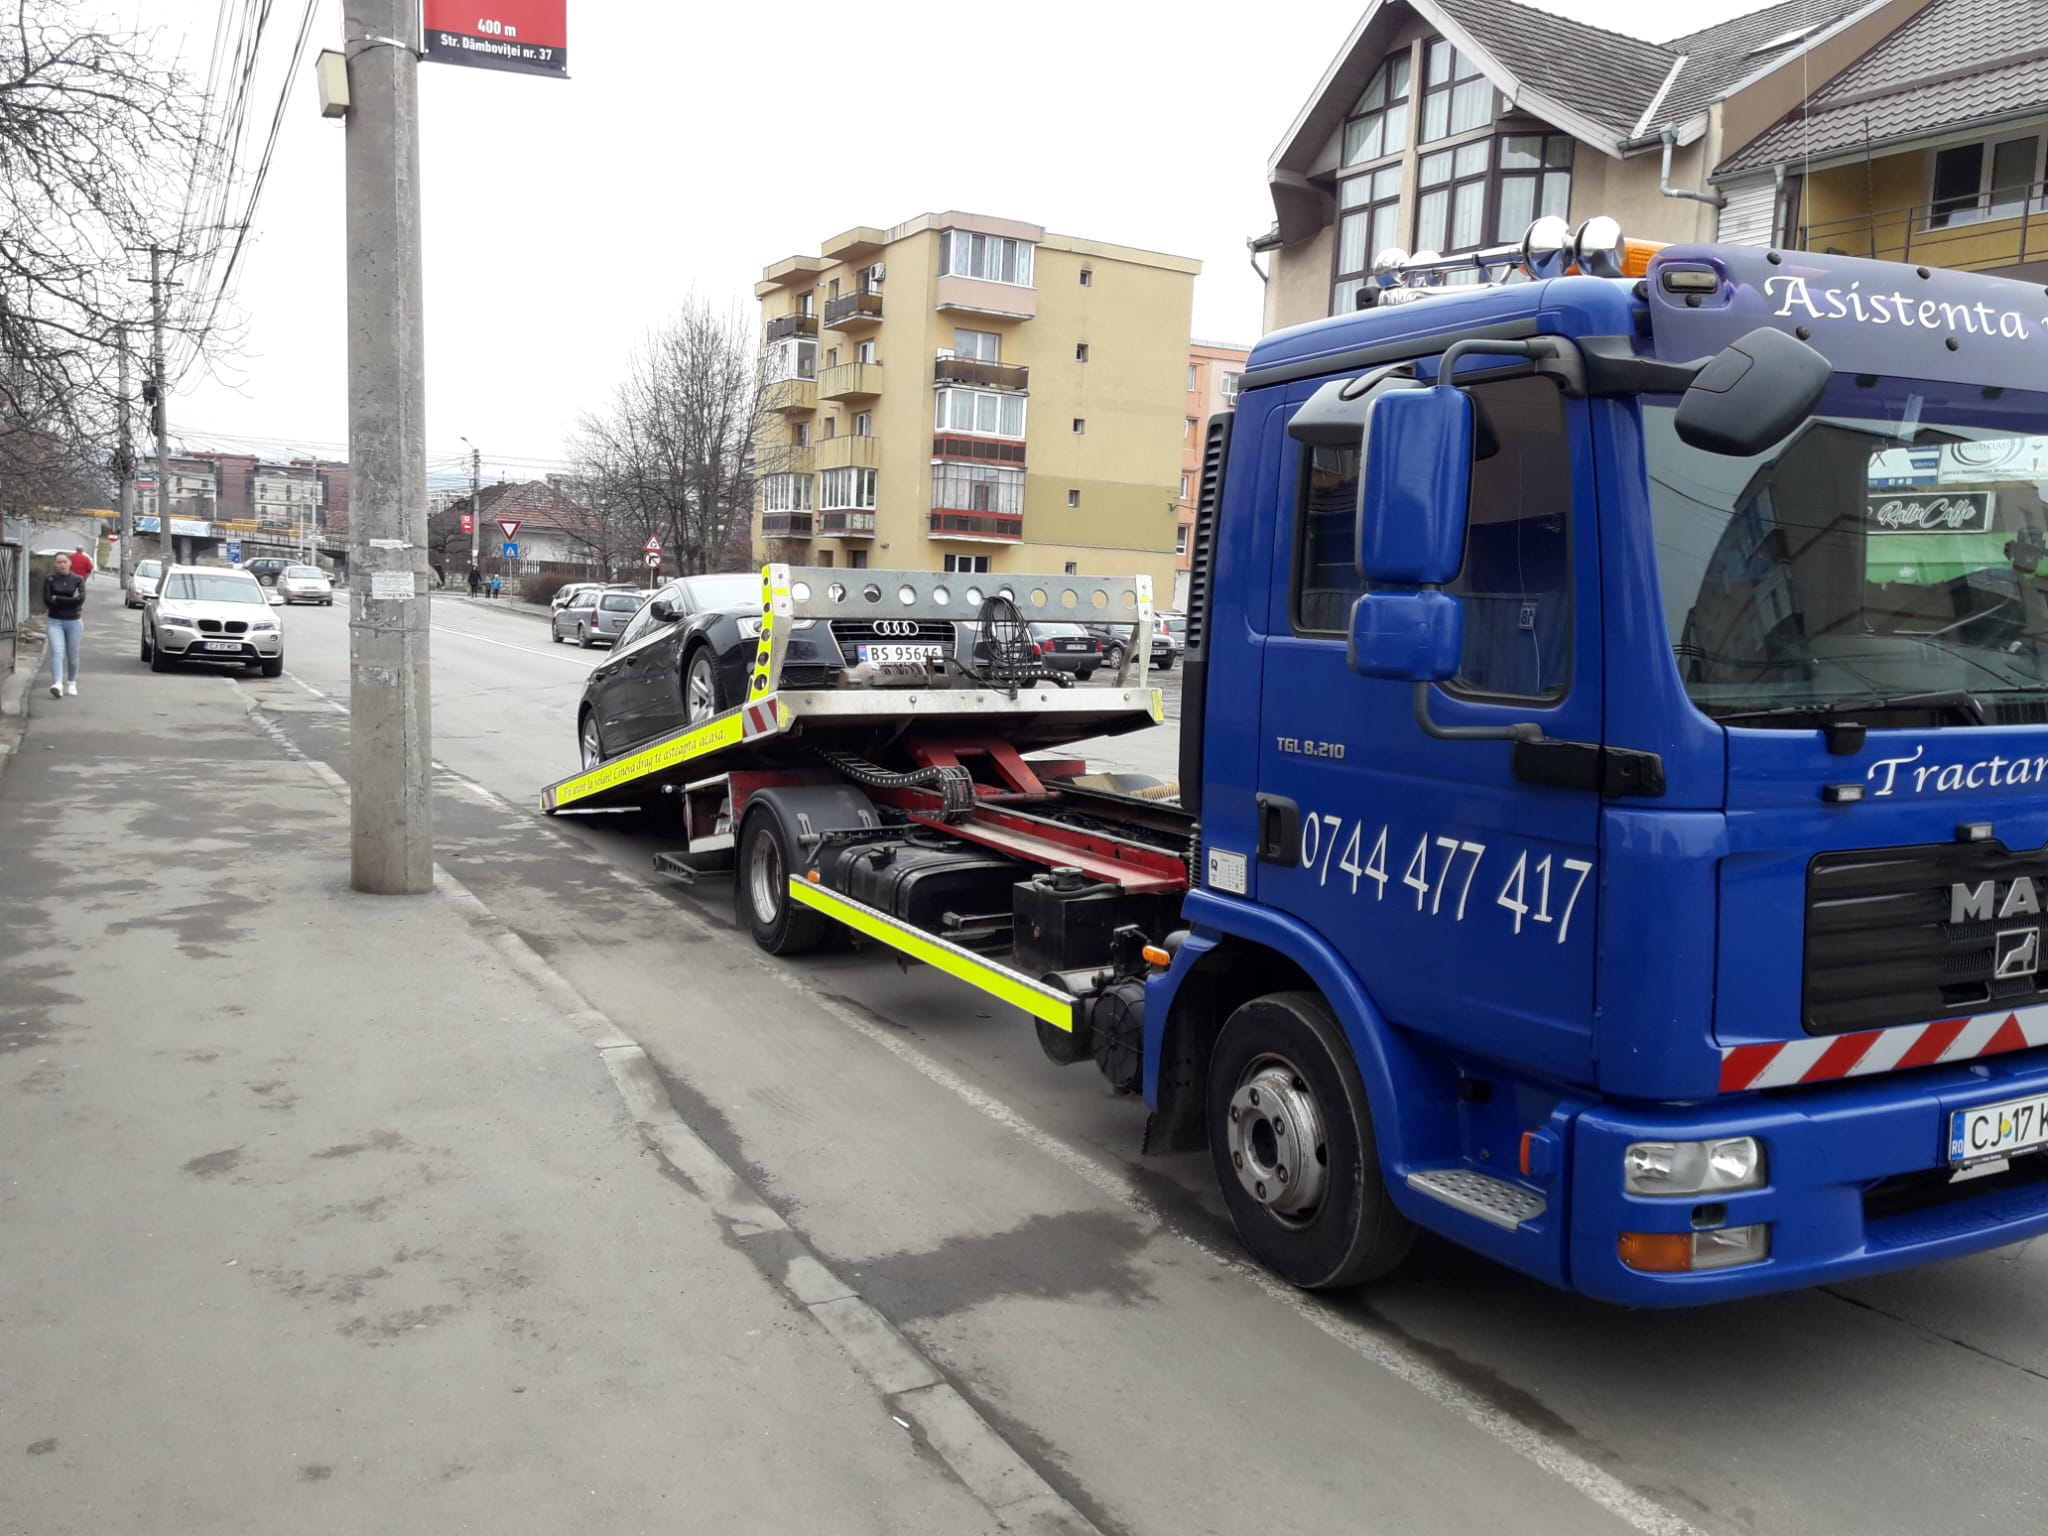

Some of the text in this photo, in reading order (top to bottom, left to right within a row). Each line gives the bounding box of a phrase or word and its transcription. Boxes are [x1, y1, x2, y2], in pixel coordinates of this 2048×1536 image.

[478, 18, 516, 37] 400 m
[440, 33, 460, 48] Str.
[523, 48, 537, 59] nr.
[539, 48, 552, 61] 37
[1764, 275, 2030, 341] Asistenta
[870, 646, 889, 661] BS
[613, 764, 635, 780] Cineva
[663, 740, 697, 760] asteapta
[1276, 736, 1345, 759] TGL 8.210
[1301, 810, 1593, 944] 0744 477 417
[1950, 876, 2048, 924] MA
[1971, 1111, 2003, 1150] CJ
[2012, 1105, 2034, 1143] 17
[1951, 1140, 1964, 1155] RO
